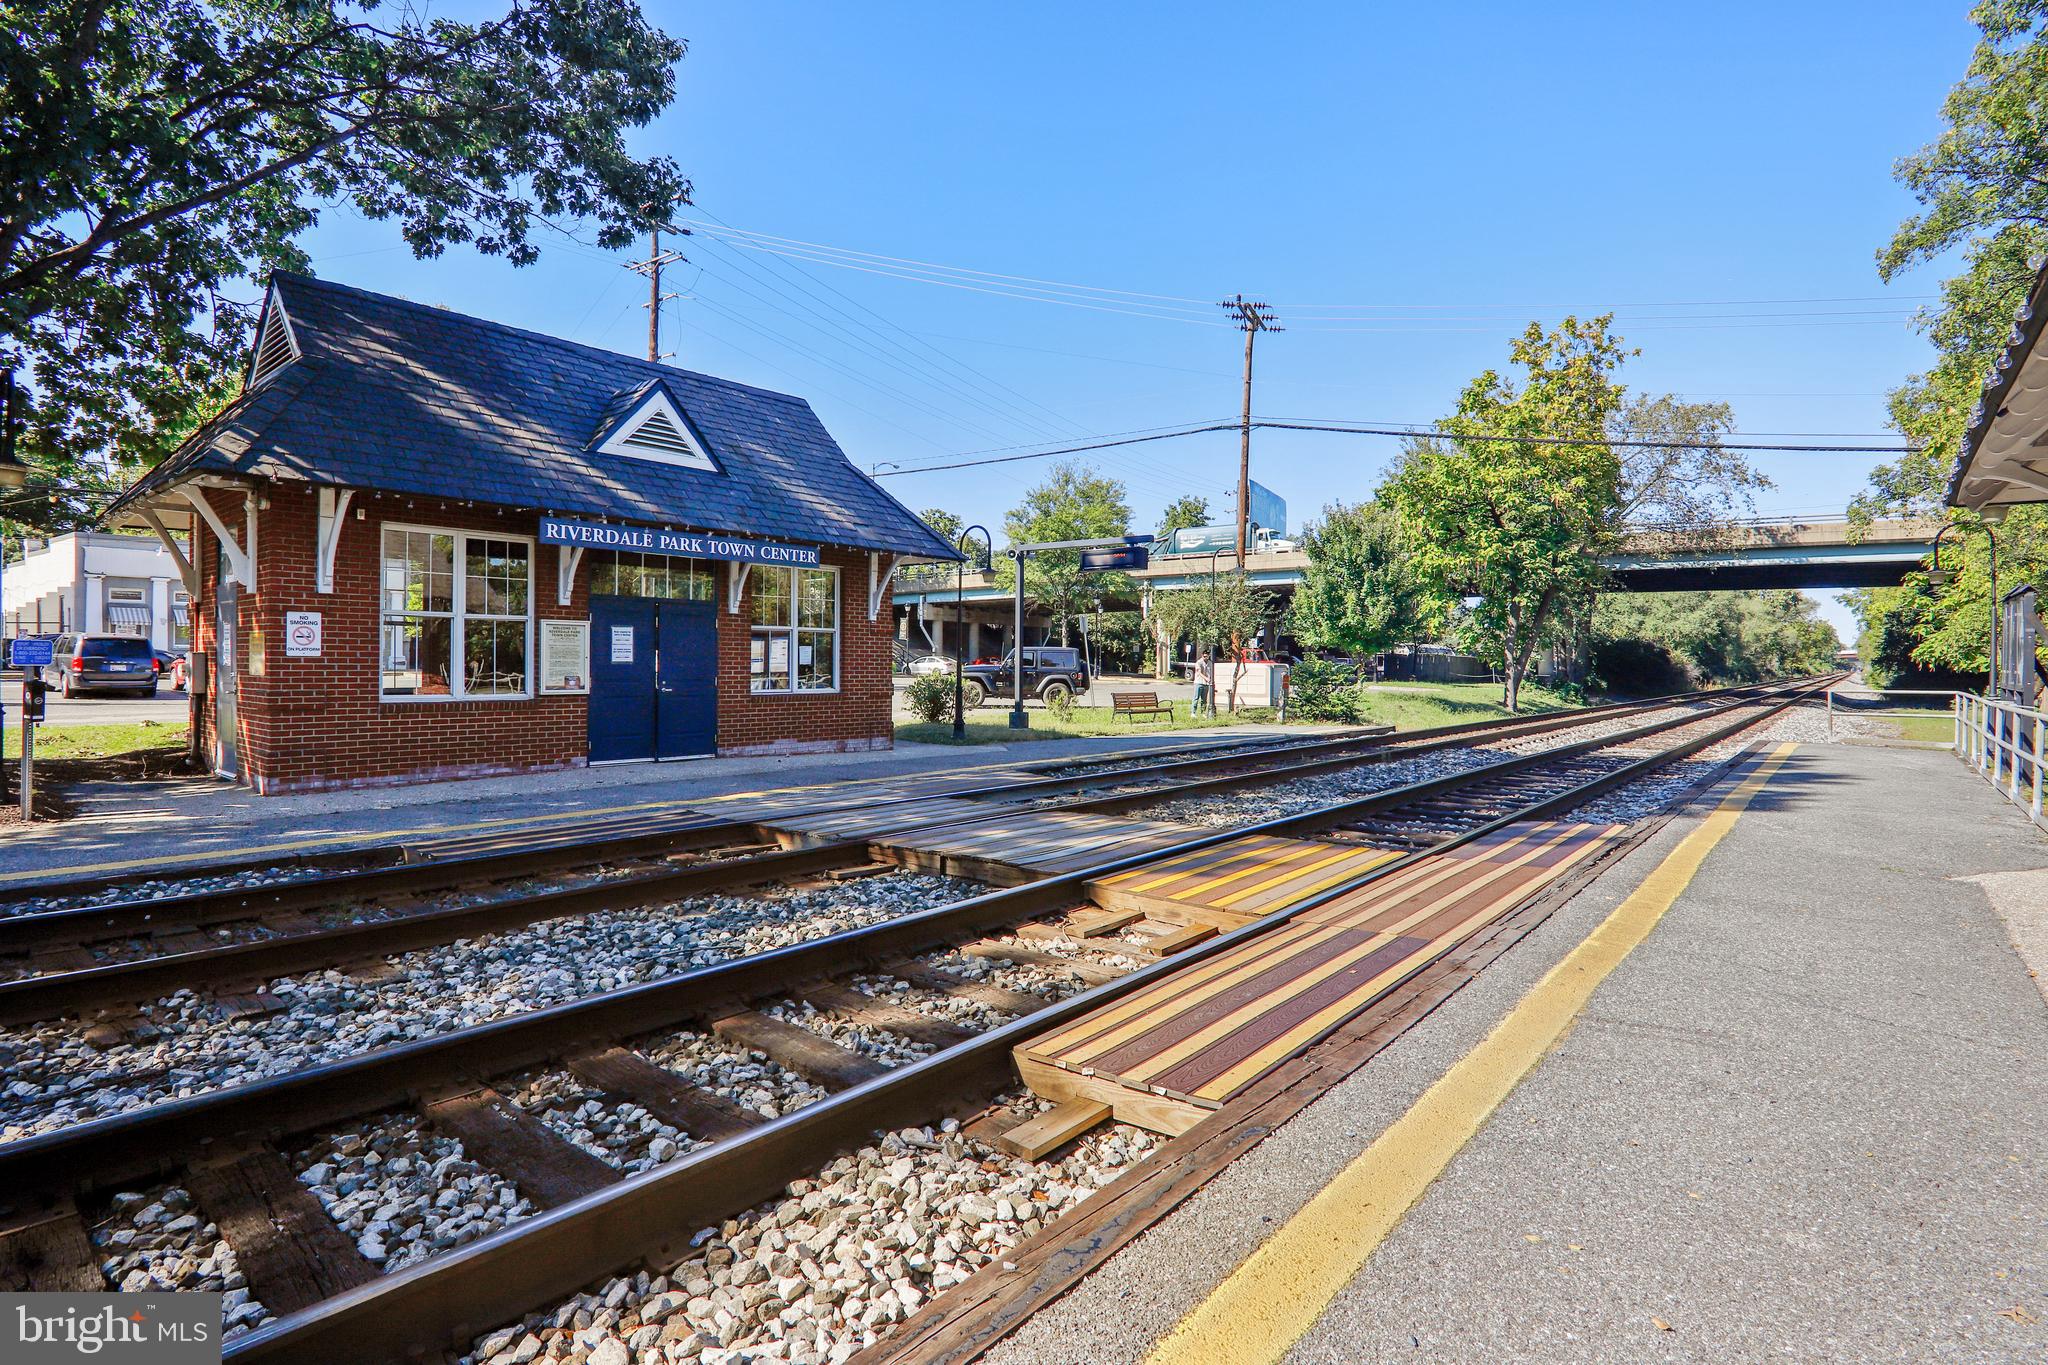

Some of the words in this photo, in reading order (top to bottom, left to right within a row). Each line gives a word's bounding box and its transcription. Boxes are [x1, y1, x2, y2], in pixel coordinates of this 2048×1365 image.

[546, 523, 653, 548] RIVERDALE
[660, 535, 703, 553] PARK
[707, 540, 755, 558] TOWN
[760, 546, 817, 564] CENTER
